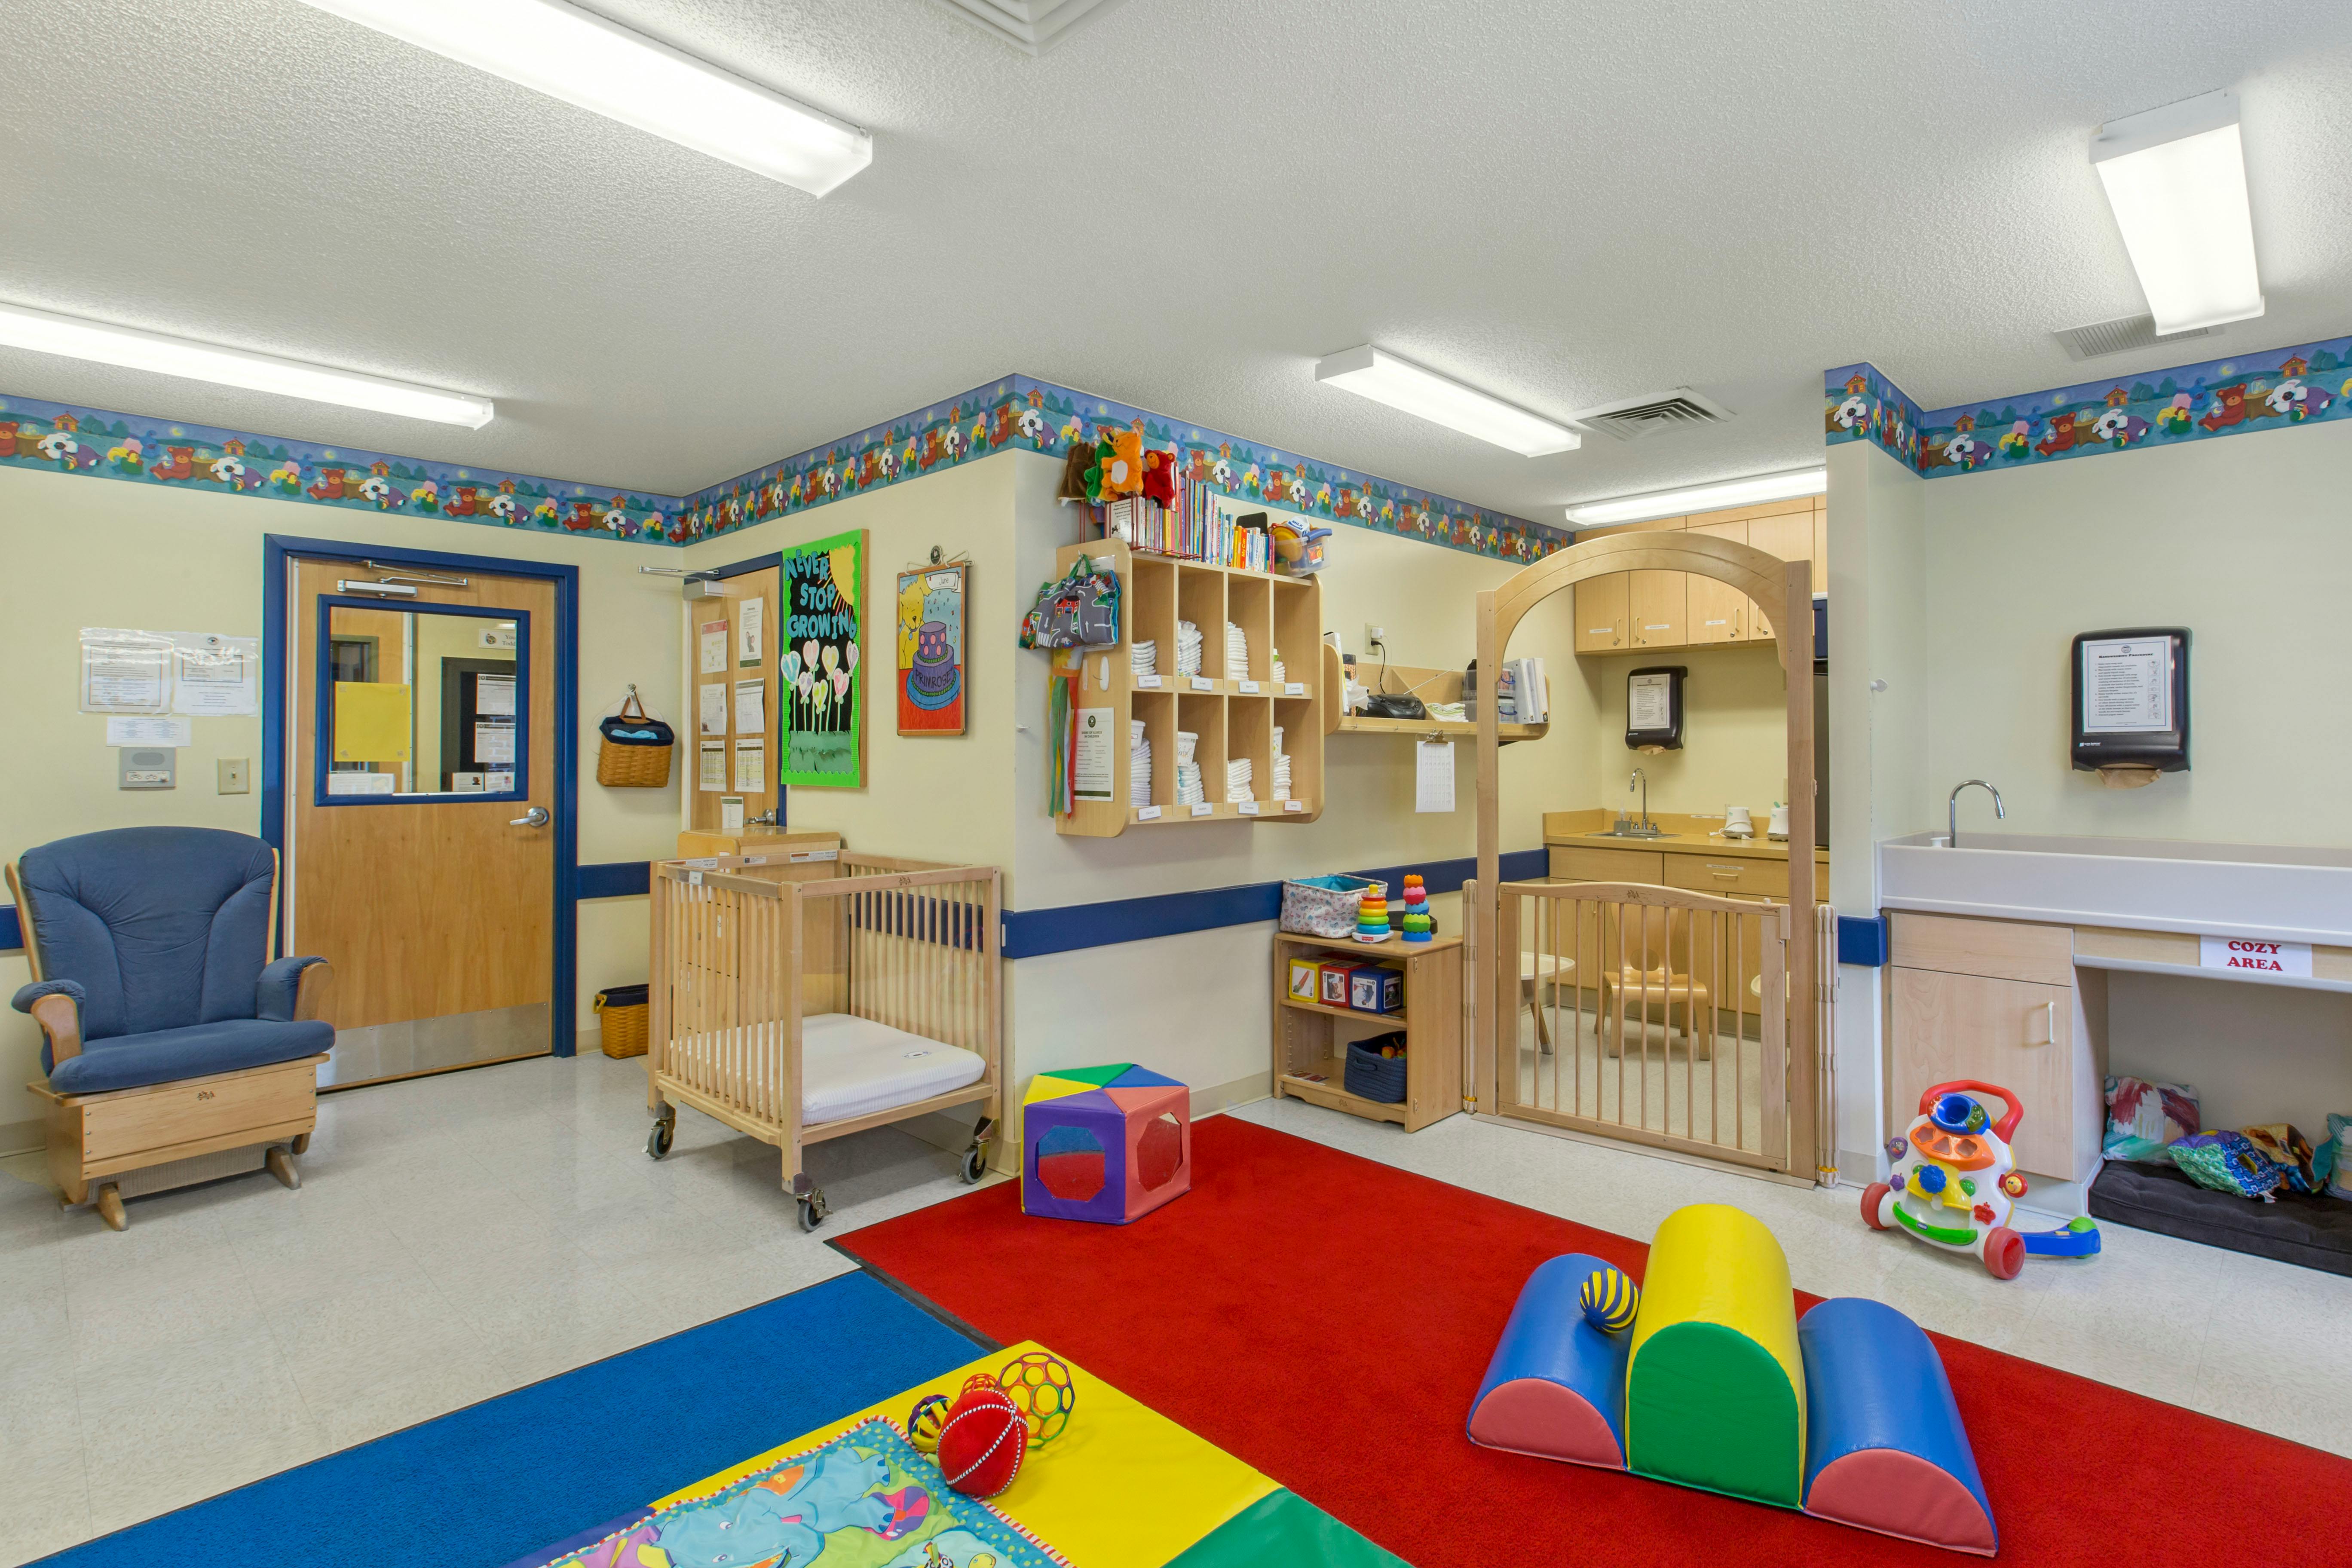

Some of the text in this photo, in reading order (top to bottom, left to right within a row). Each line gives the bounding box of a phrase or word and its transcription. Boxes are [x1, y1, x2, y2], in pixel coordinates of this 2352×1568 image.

[1242, 548, 1246, 557] My
[785, 549, 828, 580] NEVER
[939, 576, 949, 585] June
[800, 583, 835, 611] STOP
[787, 609, 857, 639] GROWING
[916, 668, 951, 689] PRIMROSE
[2228, 940, 2282, 954] COZY
[2226, 957, 2283, 971] AREA
